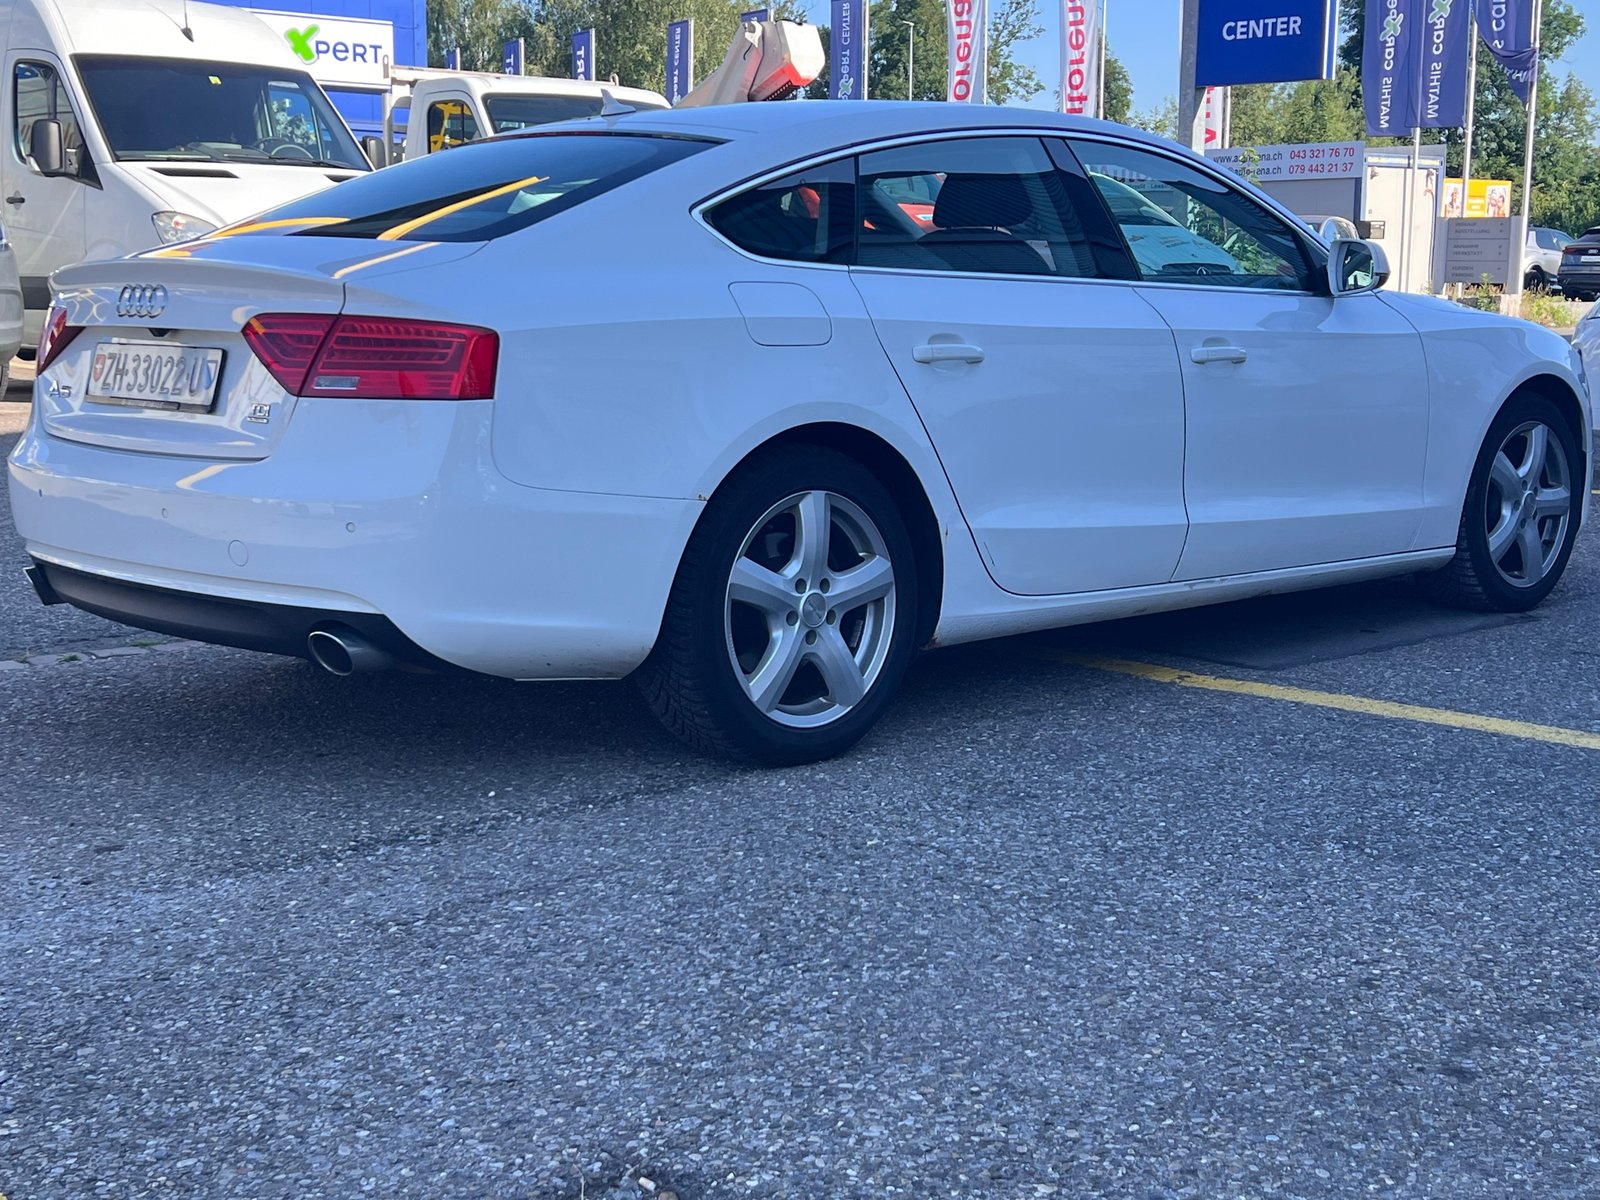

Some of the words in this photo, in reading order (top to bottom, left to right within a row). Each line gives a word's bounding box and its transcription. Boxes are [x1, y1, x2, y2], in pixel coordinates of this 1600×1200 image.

[1222, 16, 1302, 41] CENTER
[1289, 150, 1307, 160] 043
[1309, 149, 1325, 159] 321
[1329, 148, 1341, 158] 76
[1343, 147, 1355, 157] 70
[1288, 164, 1306, 174] 079
[1308, 163, 1325, 174] 443
[1327, 163, 1339, 173] 21
[1342, 162, 1354, 172] 37
[47, 380, 72, 398] A5
[251, 403, 271, 417] TDI
